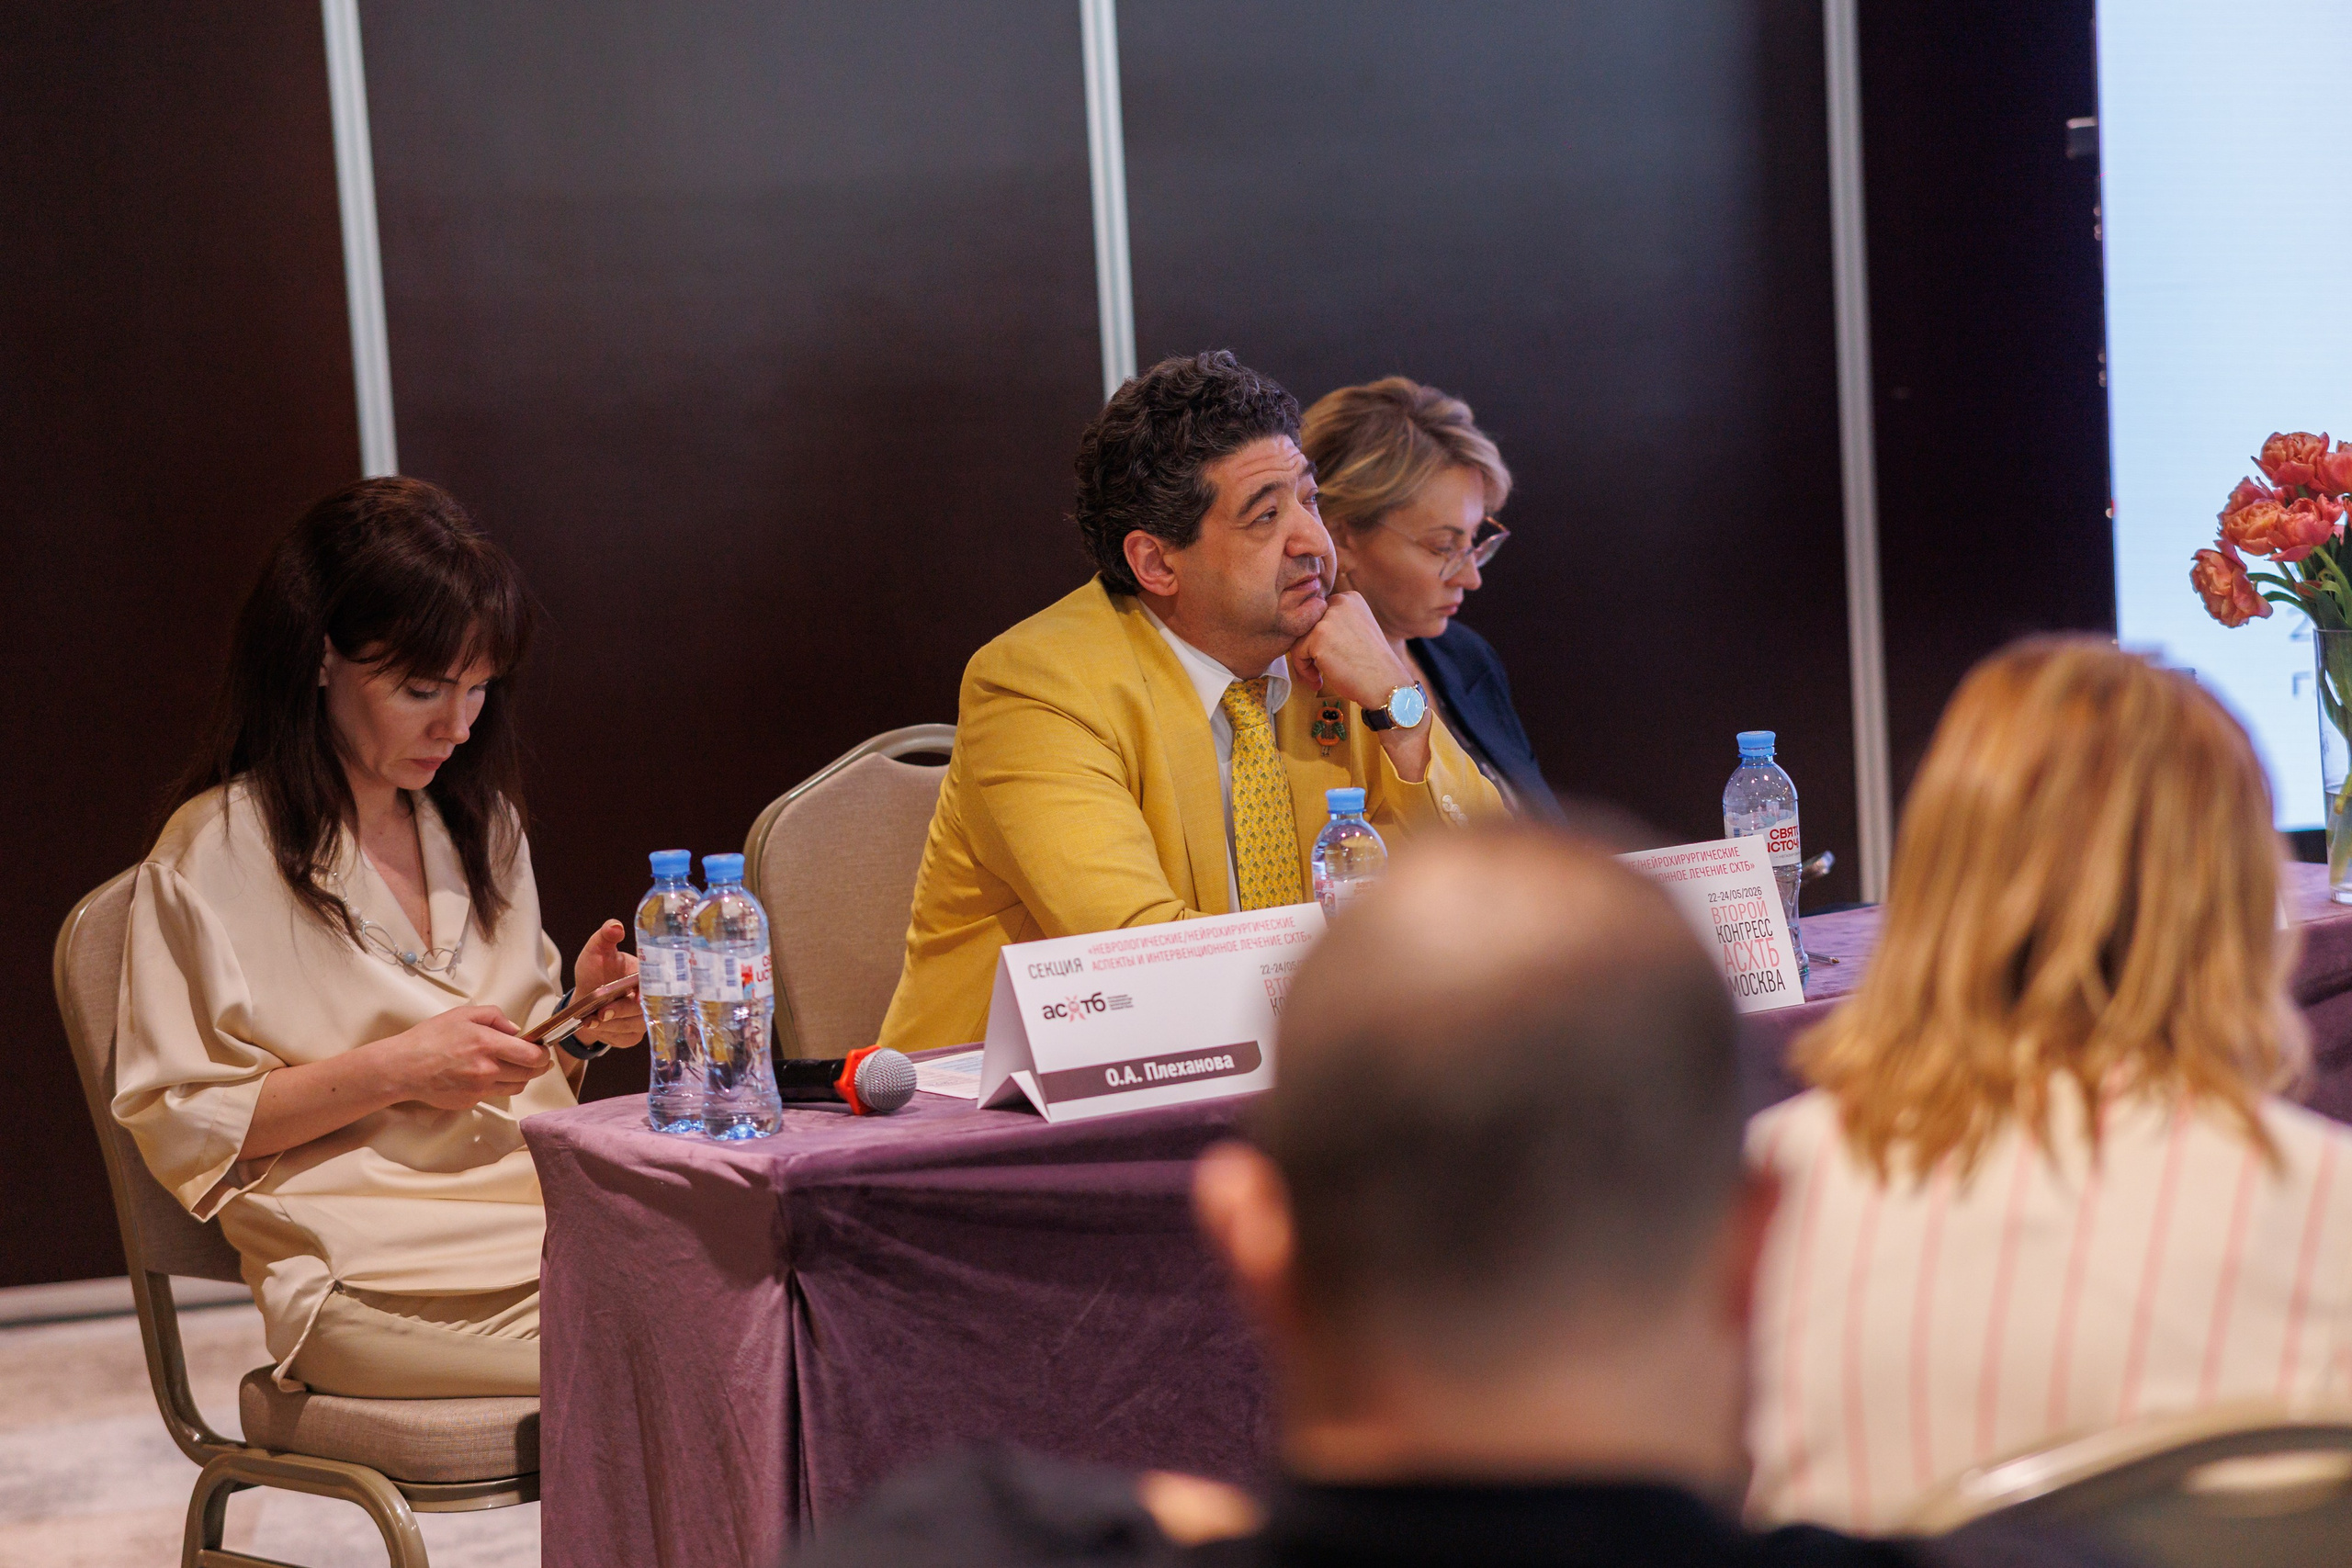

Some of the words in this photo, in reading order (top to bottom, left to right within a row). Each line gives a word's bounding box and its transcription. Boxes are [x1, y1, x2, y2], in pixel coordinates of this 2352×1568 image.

[1770, 825, 1799, 840] СВЯТ
[1767, 839, 1799, 852] СТОЧ
[1651, 869, 1689, 885] ИОННОЕ
[1690, 863, 1728, 879] ЛЕЧЕНИЕ
[1729, 860, 1756, 874] СХТБ»
[1707, 886, 1763, 903] 22-24/05/2026
[1711, 897, 1769, 925] ВТОРОЙ
[1715, 918, 1773, 944] КОНГРЕСС
[1091, 954, 1136, 971] АСПЕКТЫ
[1137, 953, 1146, 965] И
[1147, 942, 1239, 964] ИНТЕРВЕНЦИОННОЕ
[1240, 934, 1283, 952] ЛЕЧЕНИЕ
[1723, 936, 1781, 974] АСХТБ
[1027, 957, 1084, 980] СЕКЦИЯ
[1264, 976, 1292, 998] ВТО
[1727, 968, 1786, 998] МОСКВА
[1104, 1065, 1143, 1087] О.А.
[1143, 1054, 1235, 1082] Плеханова
